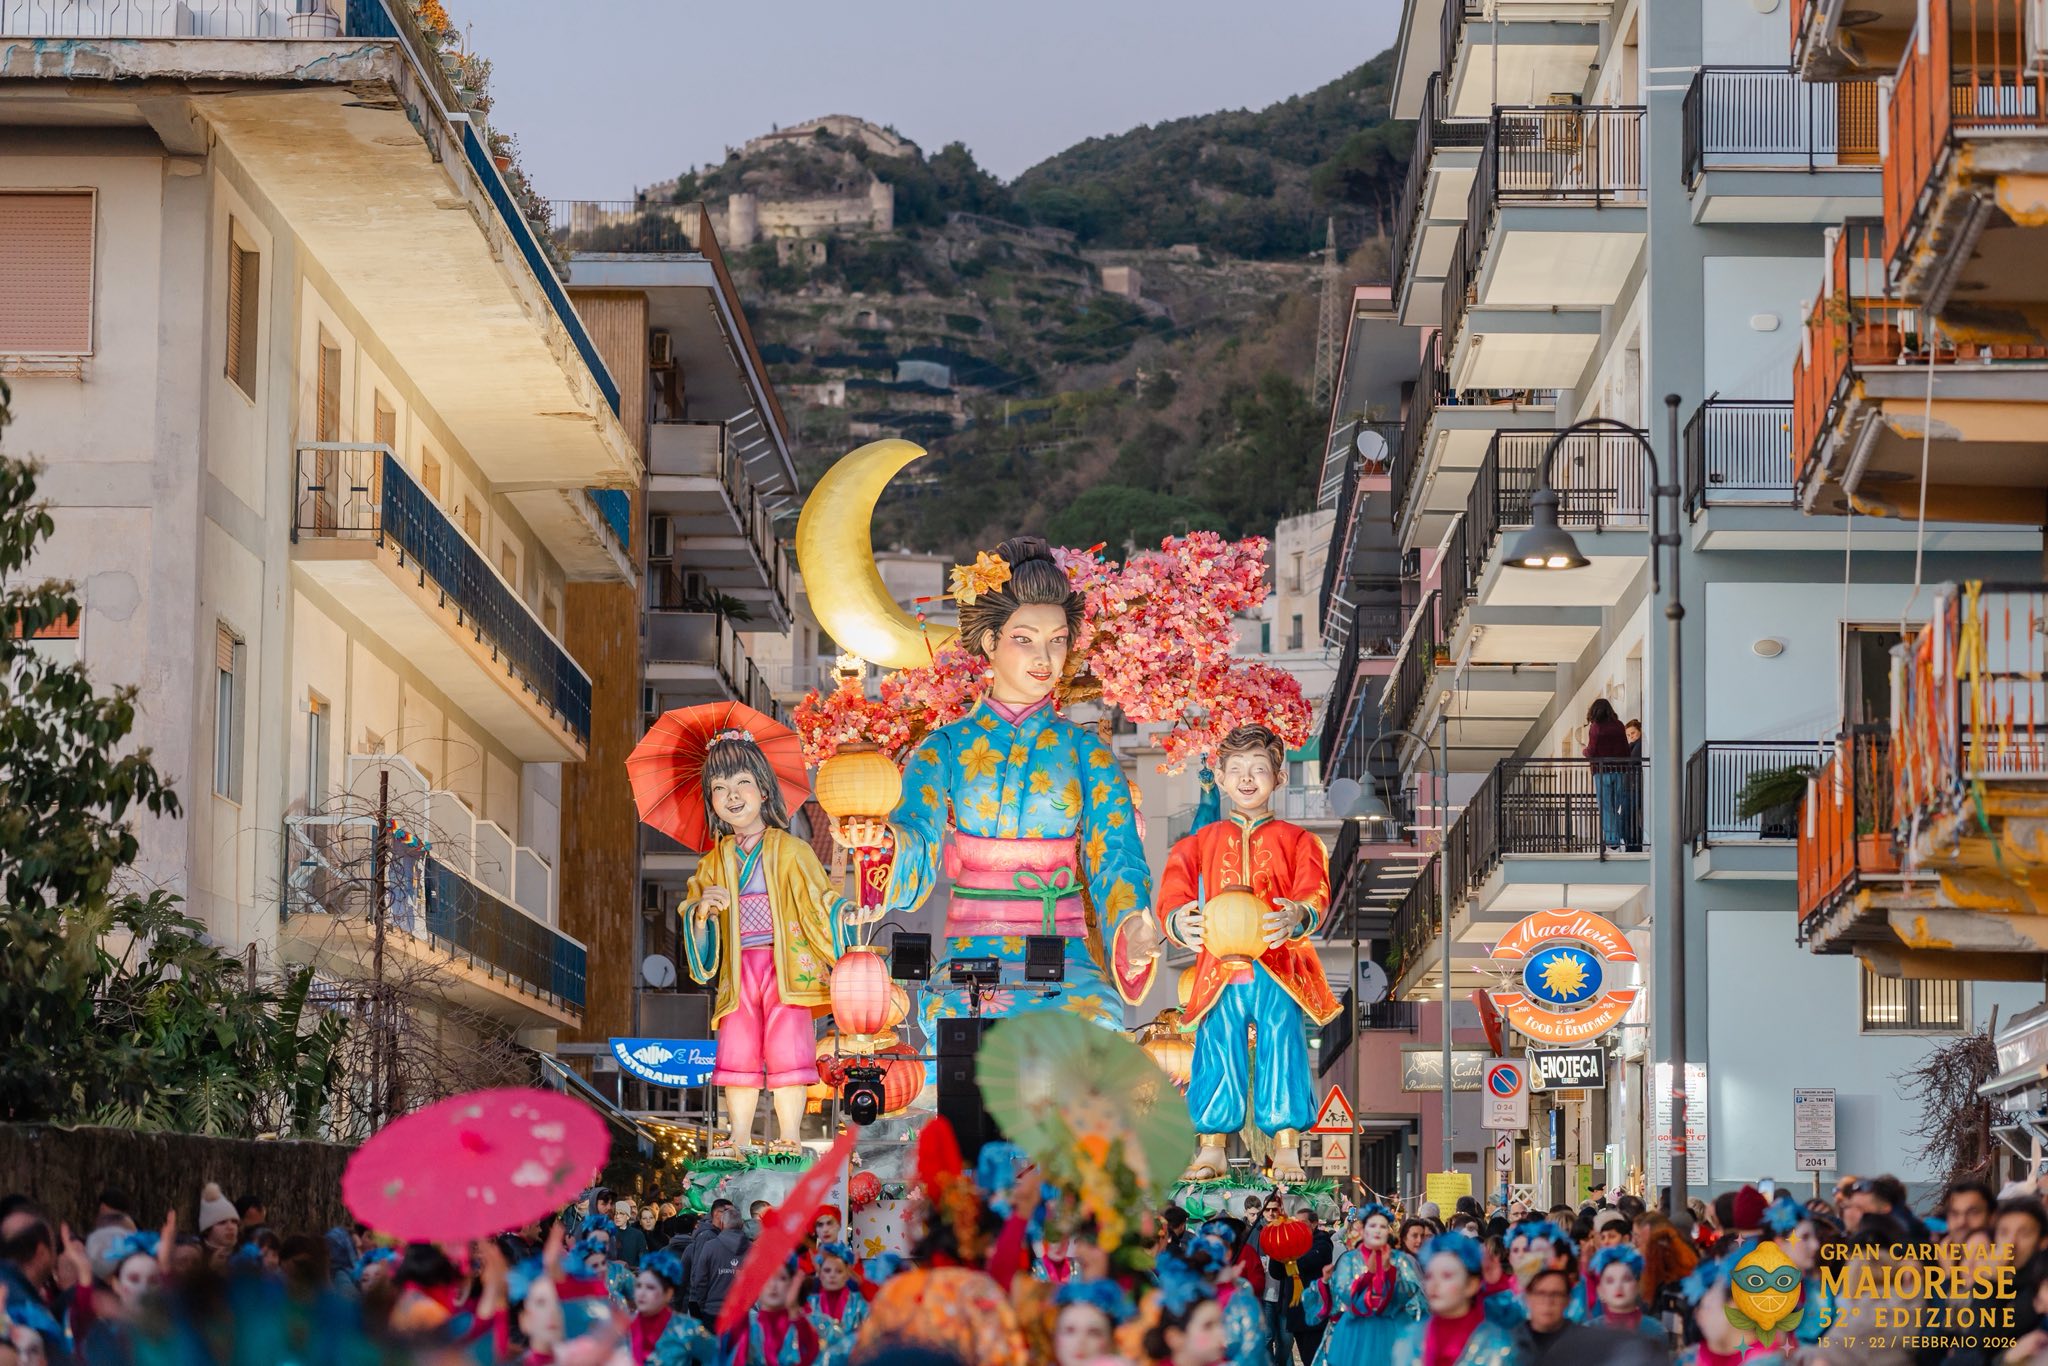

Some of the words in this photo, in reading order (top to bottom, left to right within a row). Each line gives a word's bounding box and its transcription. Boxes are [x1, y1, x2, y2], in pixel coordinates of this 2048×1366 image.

[1511, 917, 1618, 952] Macelleria
[1525, 1015, 1553, 1035] FOOD
[1566, 1010, 1613, 1036] BEVERAGE
[615, 1043, 688, 1085] RISTORANTE
[1540, 1055, 1599, 1079] ENOTECA
[1805, 1158, 1827, 1167] 2041
